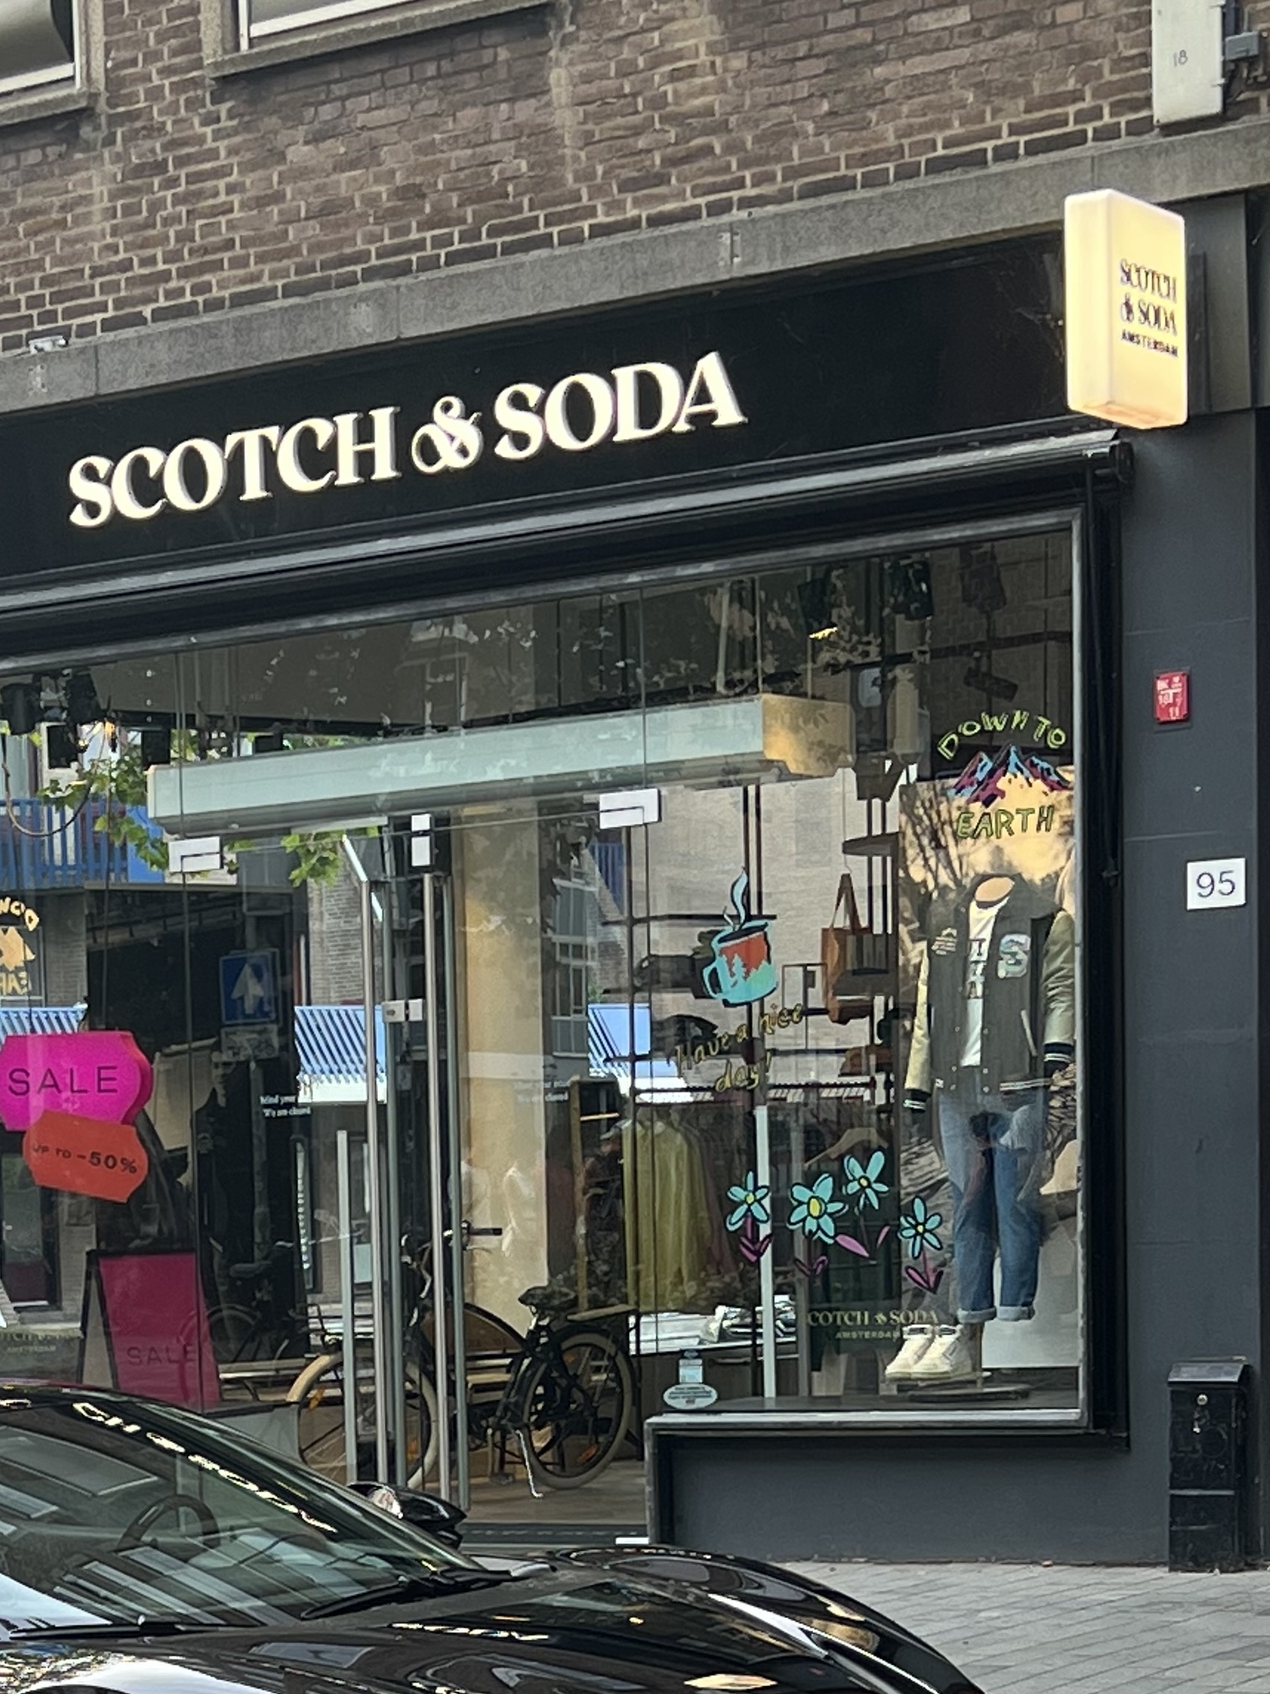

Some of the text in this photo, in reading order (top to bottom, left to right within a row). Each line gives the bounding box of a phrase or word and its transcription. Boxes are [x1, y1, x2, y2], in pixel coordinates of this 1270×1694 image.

[1120, 259, 1177, 304] SCOTCH
[1138, 299, 1177, 336] SODA
[1121, 329, 1178, 357] AMSTERDAM
[69, 350, 749, 529] SCOTCH & SODA
[937, 710, 1066, 761] DOWN TO
[956, 804, 1055, 839] EARTH
[1196, 870, 1236, 898] 95
[8, 1066, 119, 1096] SALE
[807, 1311, 870, 1327] COTCH
[890, 1310, 939, 1324] SODA
[127, 1343, 196, 1366] SALE
